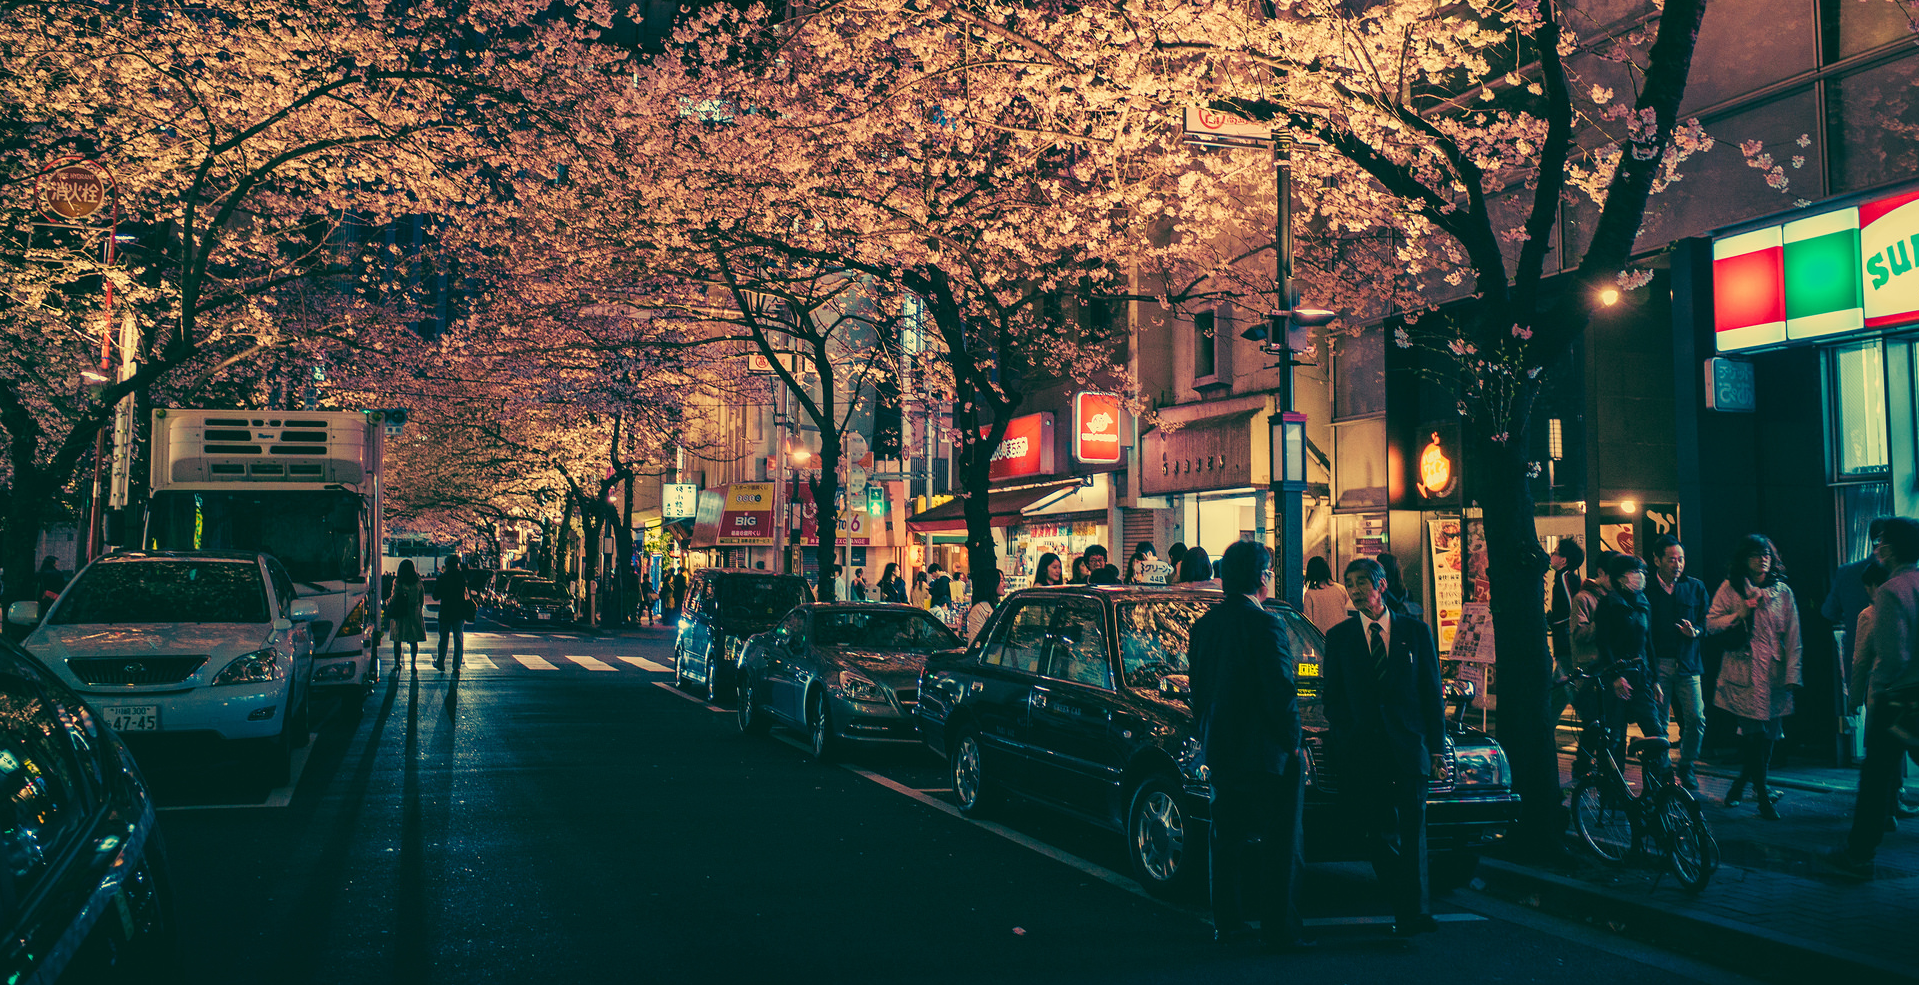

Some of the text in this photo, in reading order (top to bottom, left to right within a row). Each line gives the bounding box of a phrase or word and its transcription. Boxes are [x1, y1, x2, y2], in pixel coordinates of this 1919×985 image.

[51, 181, 100, 204] 消火栓
[851, 514, 861, 532] 6
[1298, 663, 1319, 676] 回送
[132, 707, 147, 715] 300
[114, 716, 156, 730] 47-45
